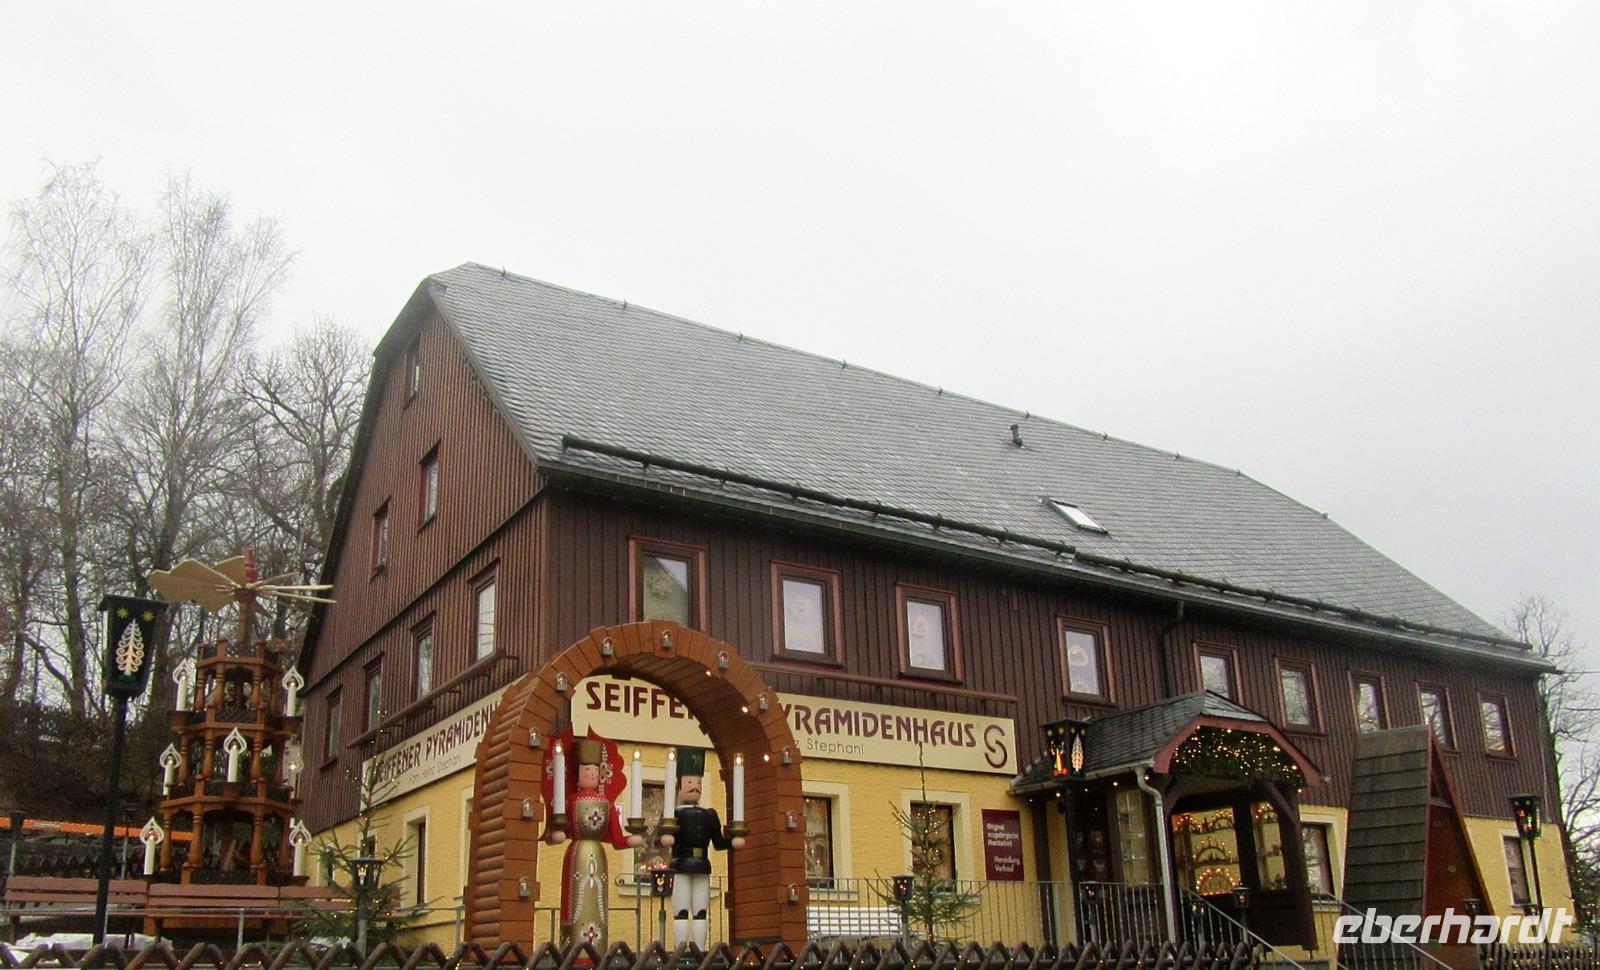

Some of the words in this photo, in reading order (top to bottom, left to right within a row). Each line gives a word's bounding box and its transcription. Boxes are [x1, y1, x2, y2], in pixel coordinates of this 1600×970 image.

[586, 681, 694, 720] SEIFFE
[374, 741, 421, 783] EIFFENER
[806, 738, 864, 755] Stephani
